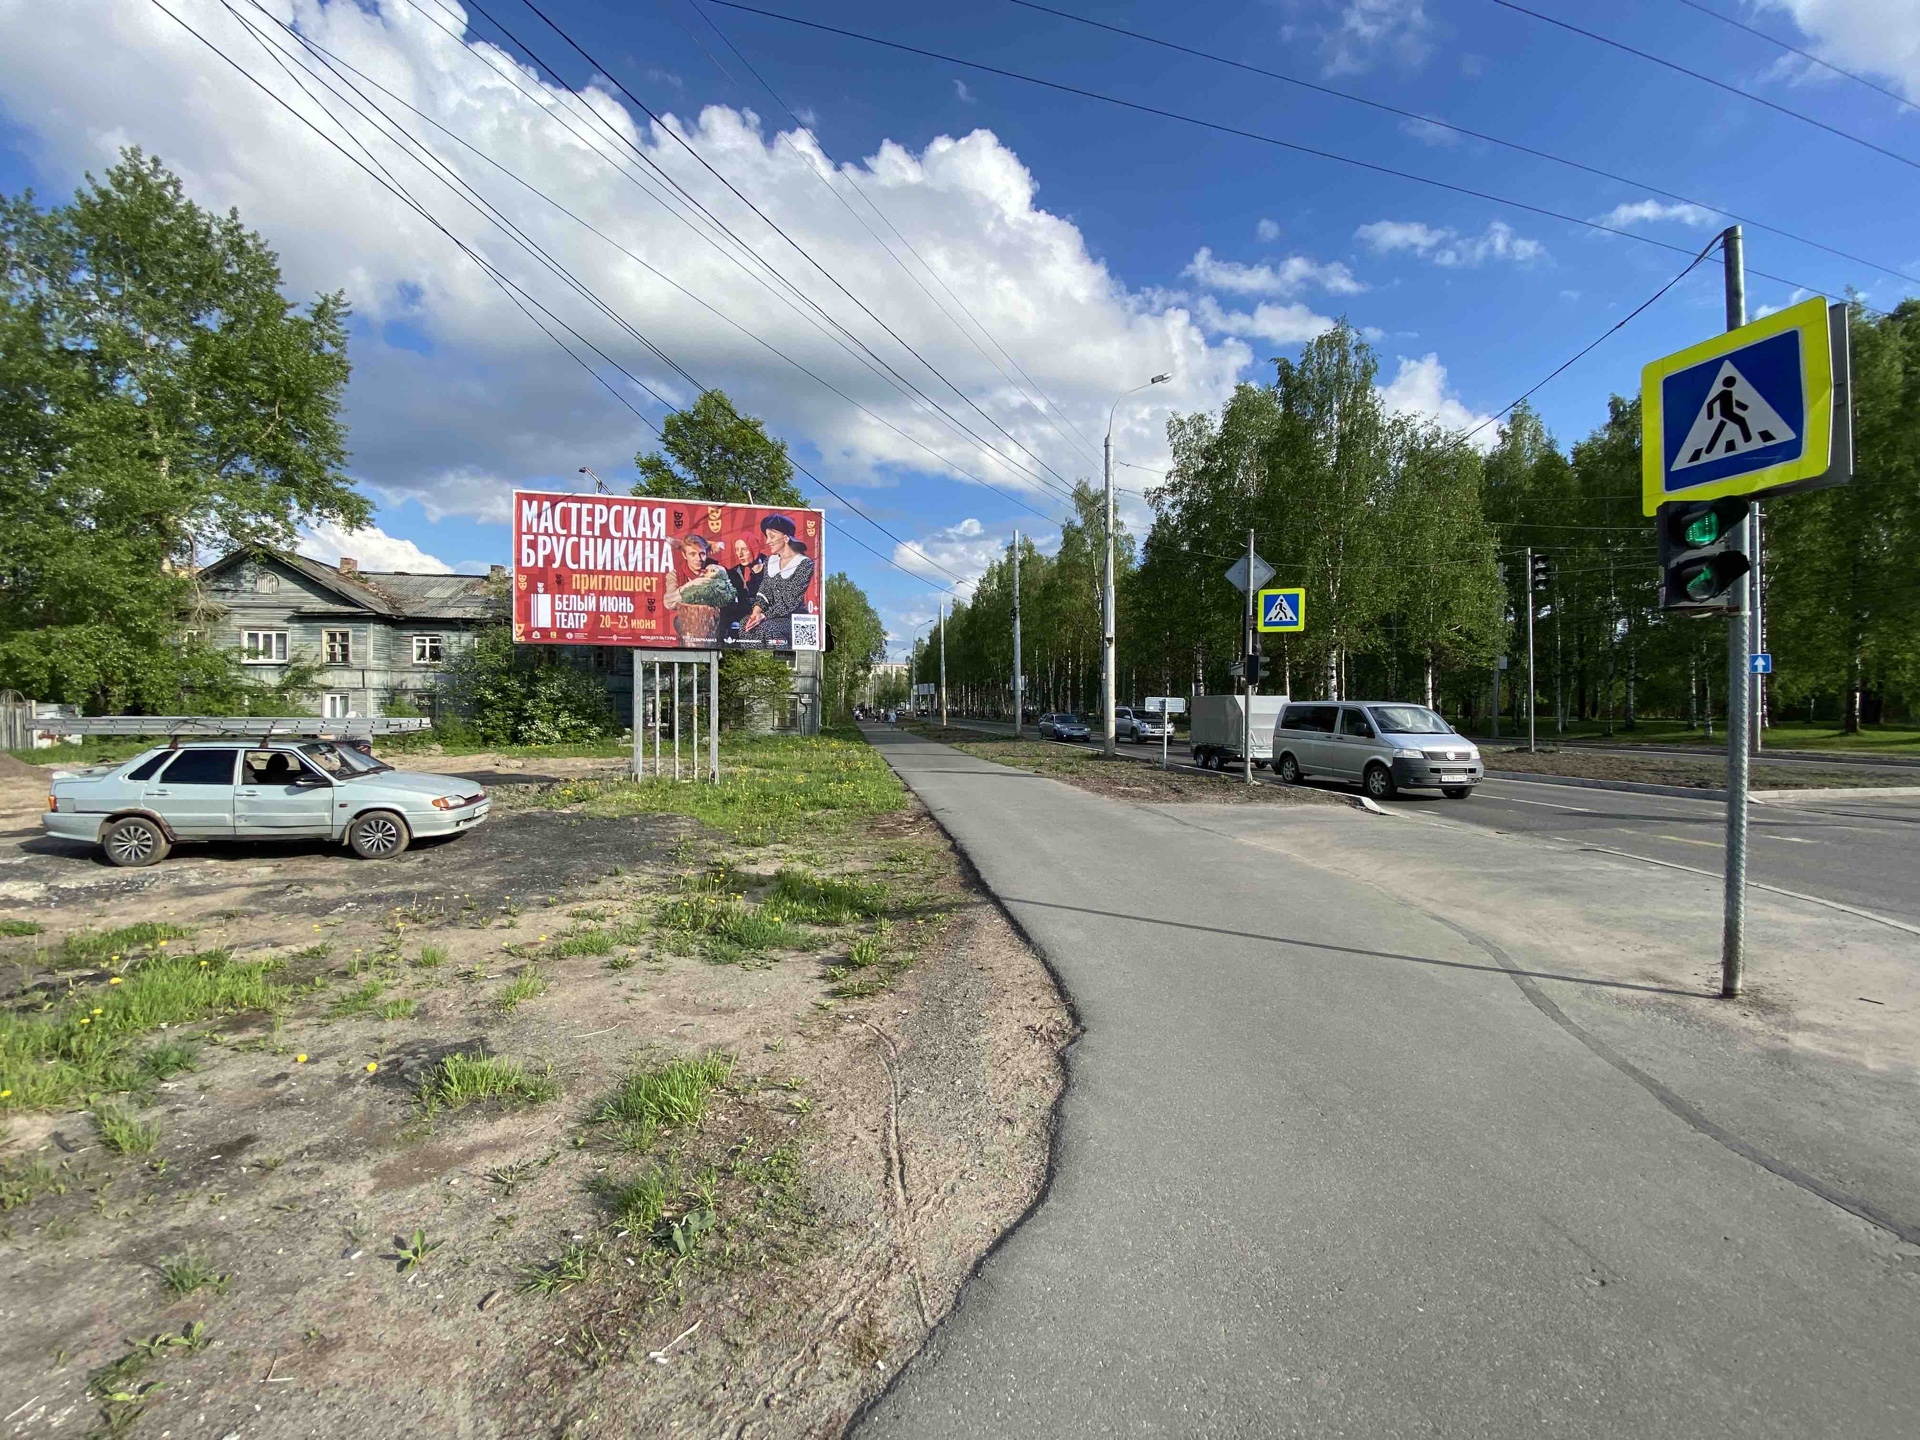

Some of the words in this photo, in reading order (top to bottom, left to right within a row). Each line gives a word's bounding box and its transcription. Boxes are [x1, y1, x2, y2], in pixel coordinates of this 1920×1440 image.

[522, 500, 666, 539] МАСТЕРСКАЯ
[521, 534, 674, 573] БРУСНИКИНА
[572, 574, 658, 594] приглашает
[555, 593, 596, 612] БЕЛЫЙ
[600, 595, 634, 612] ИЮНЬ
[808, 600, 819, 613] 0+
[555, 613, 588, 629] ТЕАТР
[631, 619, 656, 629] июня
